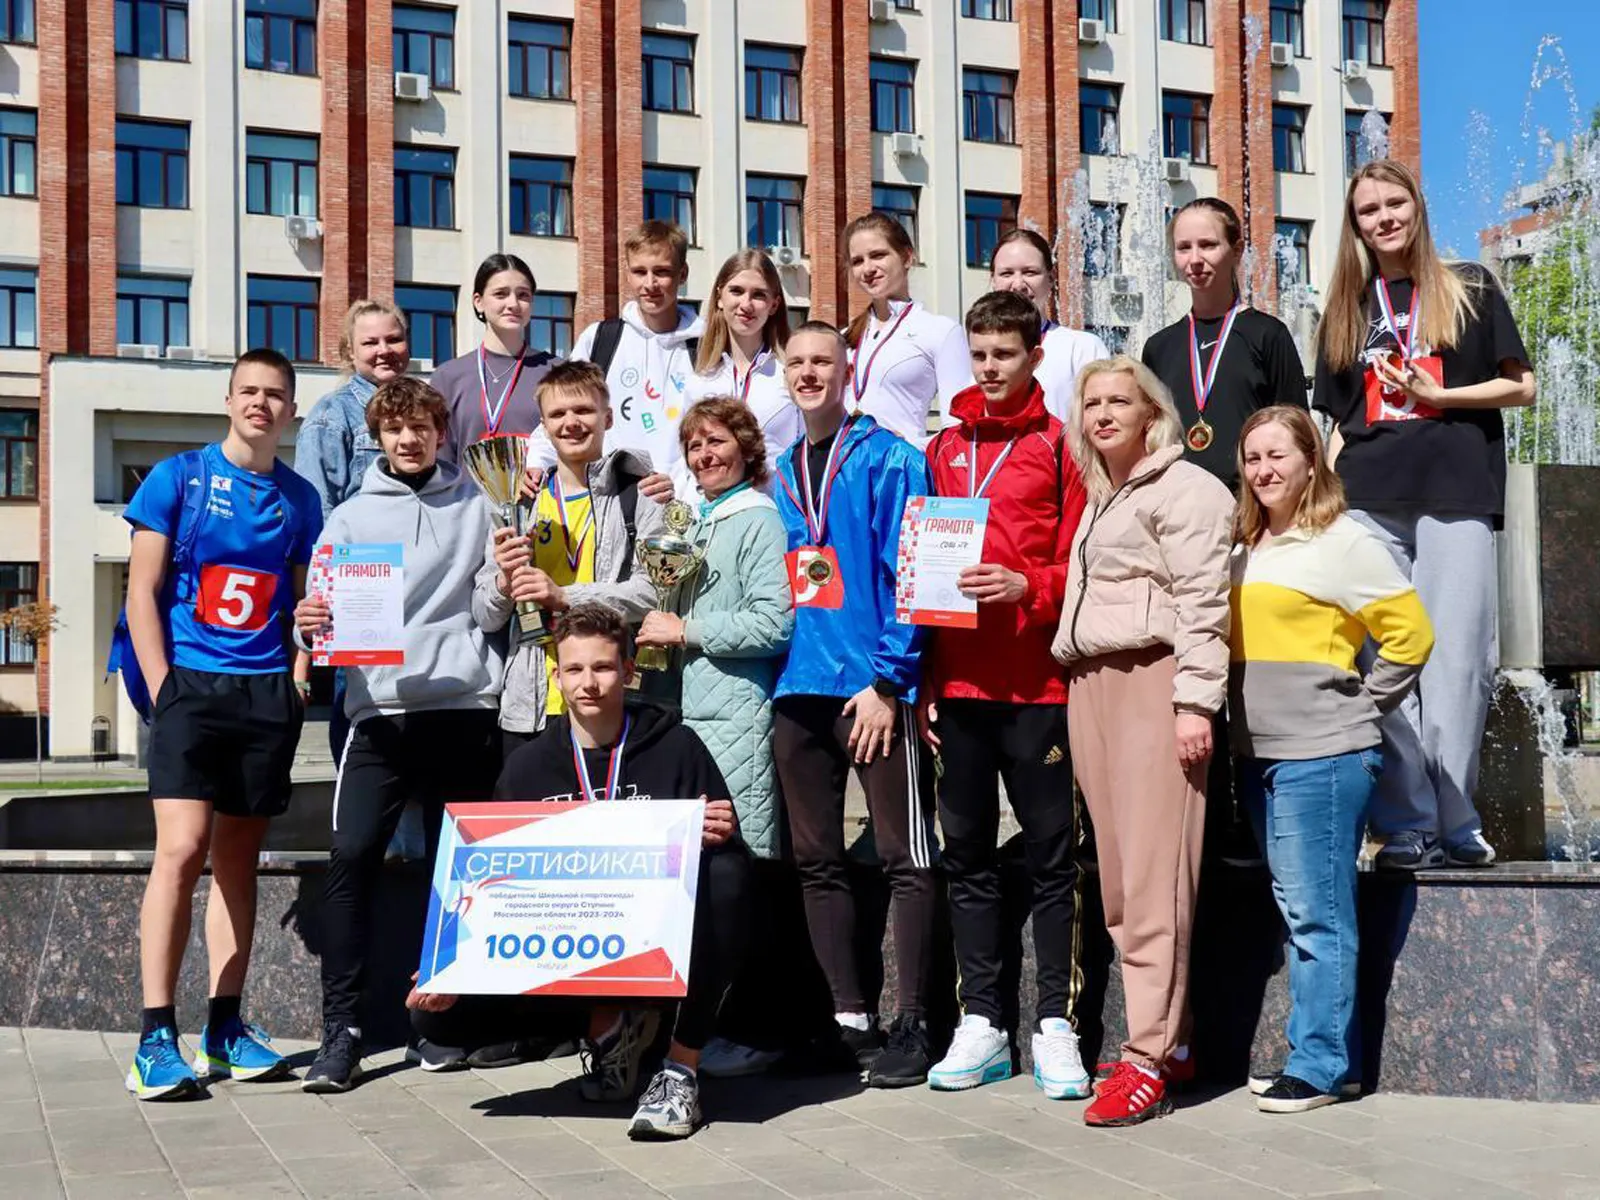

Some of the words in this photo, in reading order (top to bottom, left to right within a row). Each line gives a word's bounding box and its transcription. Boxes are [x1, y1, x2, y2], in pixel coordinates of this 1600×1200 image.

[538, 519, 552, 545] 3
[924, 518, 975, 535] ГРАМОТА
[339, 563, 391, 578] ГРАМОТА
[217, 573, 256, 626] 5
[465, 850, 668, 877] СЕРТИФИКАТ
[485, 933, 546, 959] 100
[552, 933, 625, 959] 000
